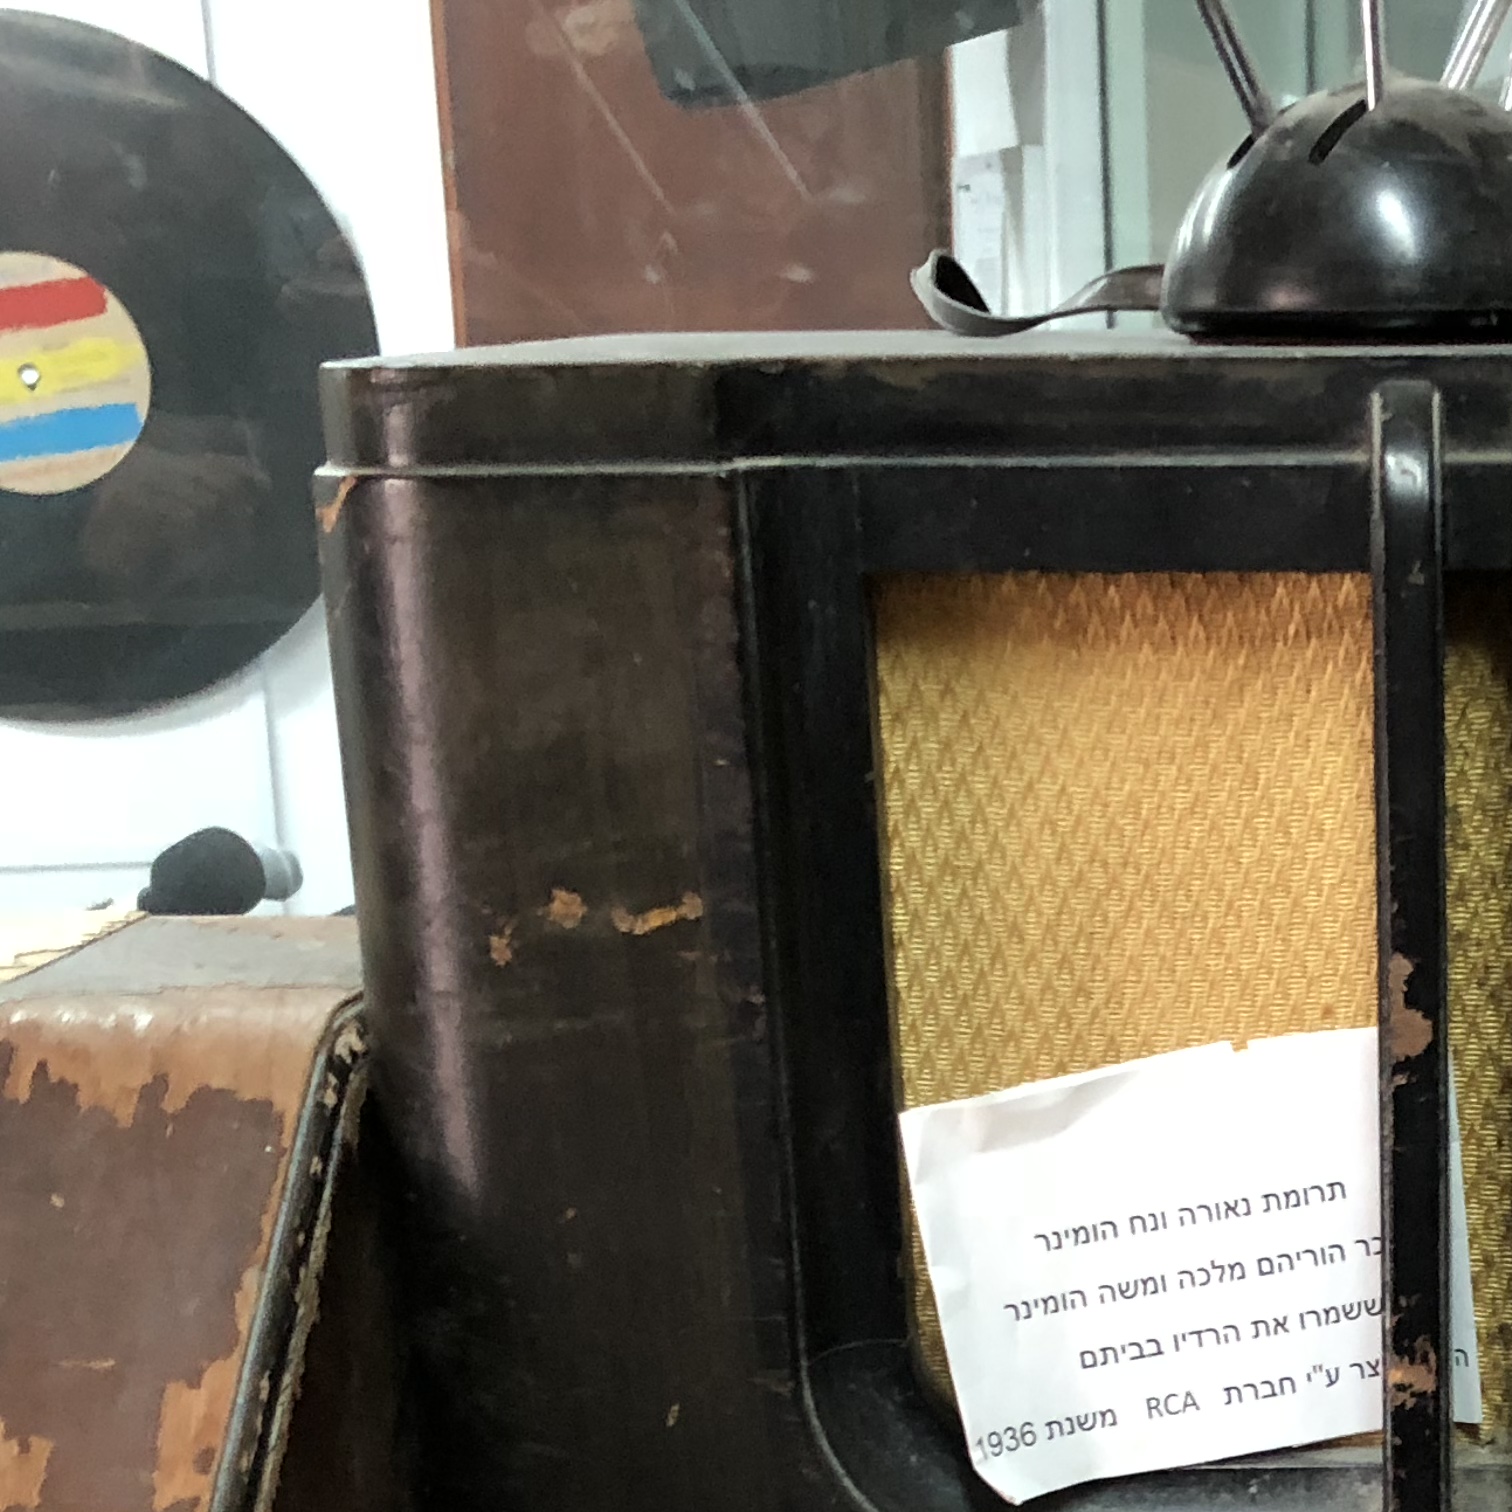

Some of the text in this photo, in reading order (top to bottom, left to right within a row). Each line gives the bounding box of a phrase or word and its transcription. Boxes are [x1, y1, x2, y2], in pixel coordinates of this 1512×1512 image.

[1033, 1180, 1347, 1251] תרומת נאורה ונח הומינר
[1003, 1236, 1383, 1322] כר הוריהם מלכה ומשה הומינר
[1173, 1324, 1241, 1353] הרדיו
[1251, 1314, 1290, 1339] את
[1079, 1338, 1165, 1370] בביתם
[1146, 1390, 1201, 1420] RCA
[1223, 1374, 1297, 1406] חברת
[1045, 1408, 1118, 1441] משנת
[975, 1421, 1038, 1461] 1936
